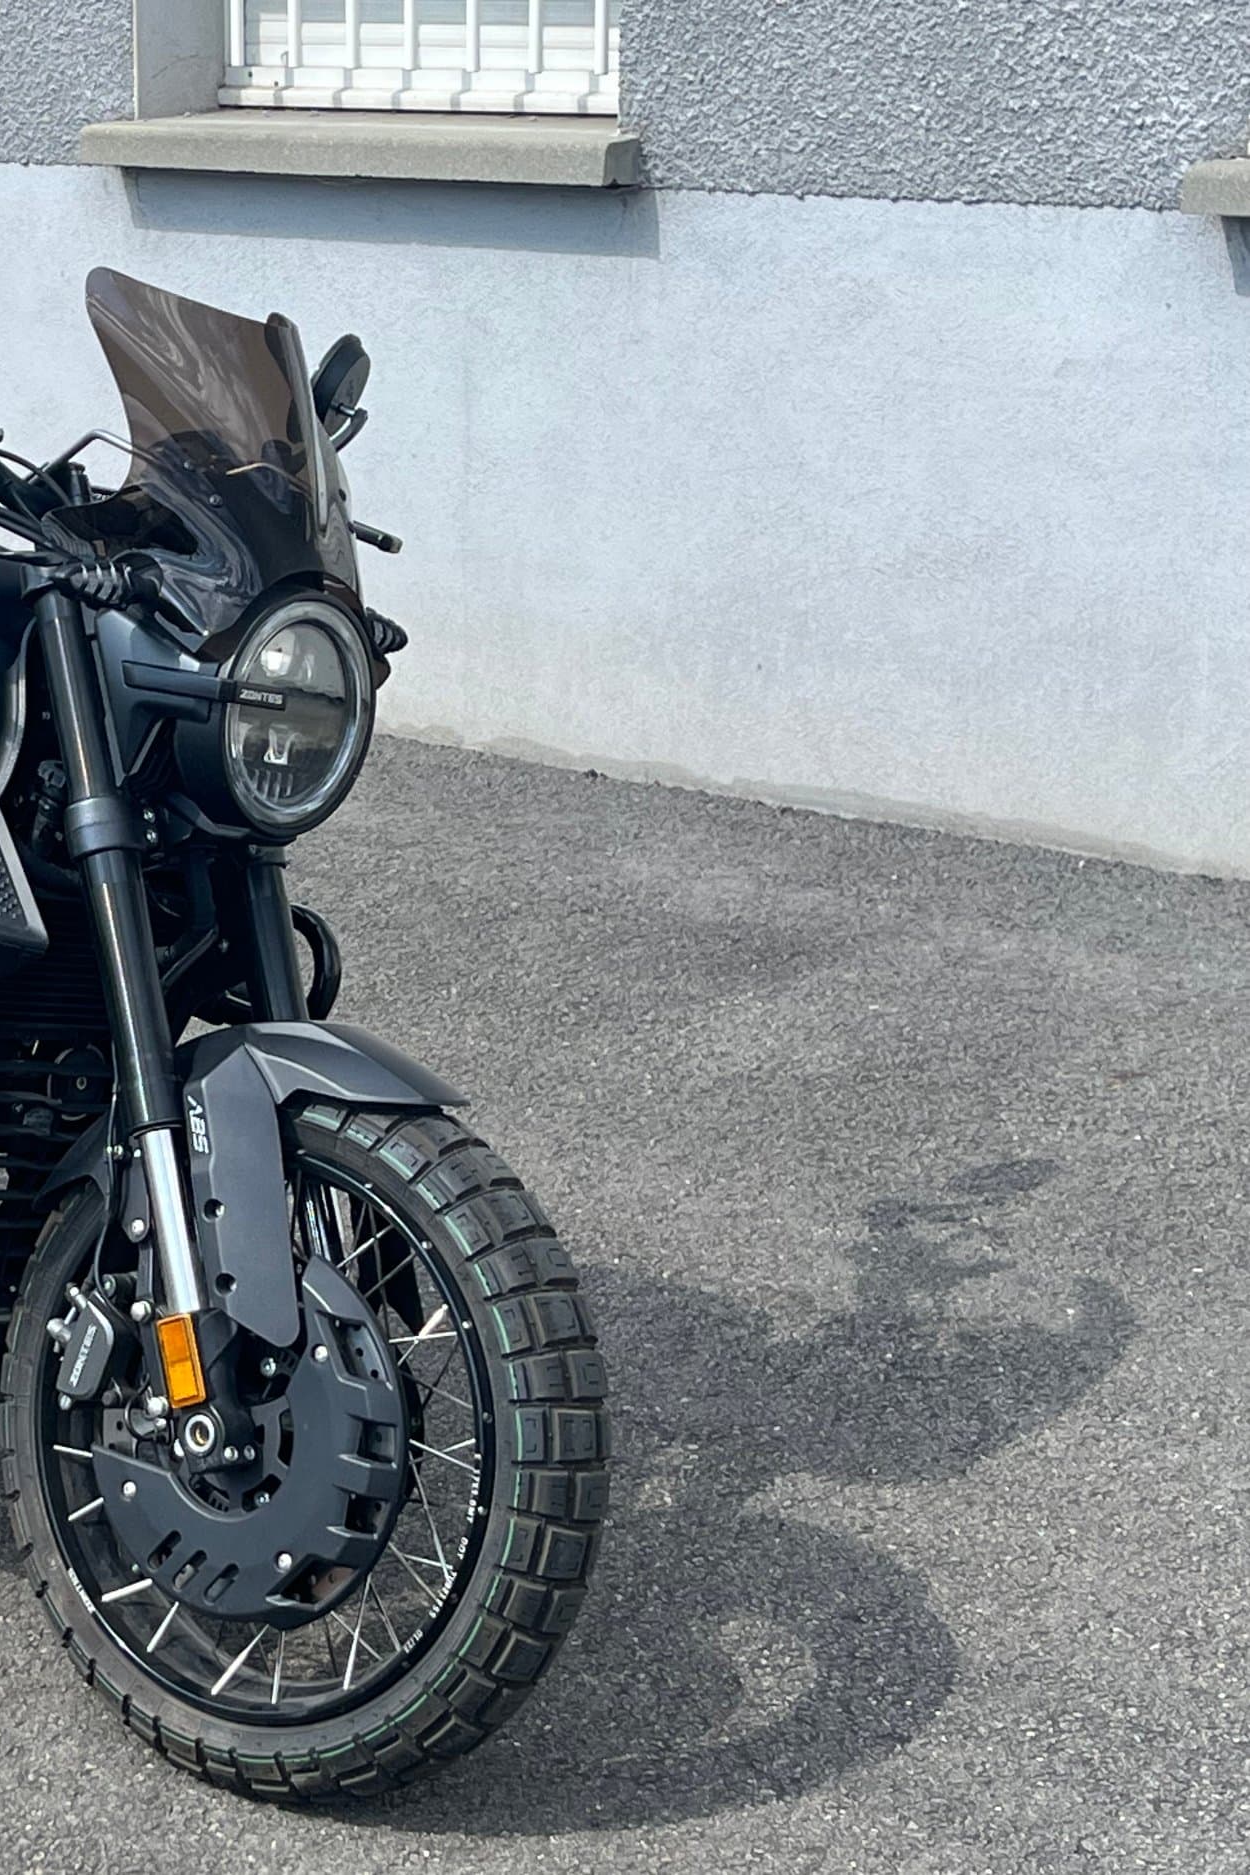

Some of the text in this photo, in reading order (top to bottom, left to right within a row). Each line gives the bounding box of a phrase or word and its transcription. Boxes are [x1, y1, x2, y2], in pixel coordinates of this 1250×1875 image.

[239, 688, 283, 705] ZONTES
[187, 1095, 209, 1154] ABS
[69, 1324, 97, 1387] ZONTES
[456, 1536, 469, 1560] DOT
